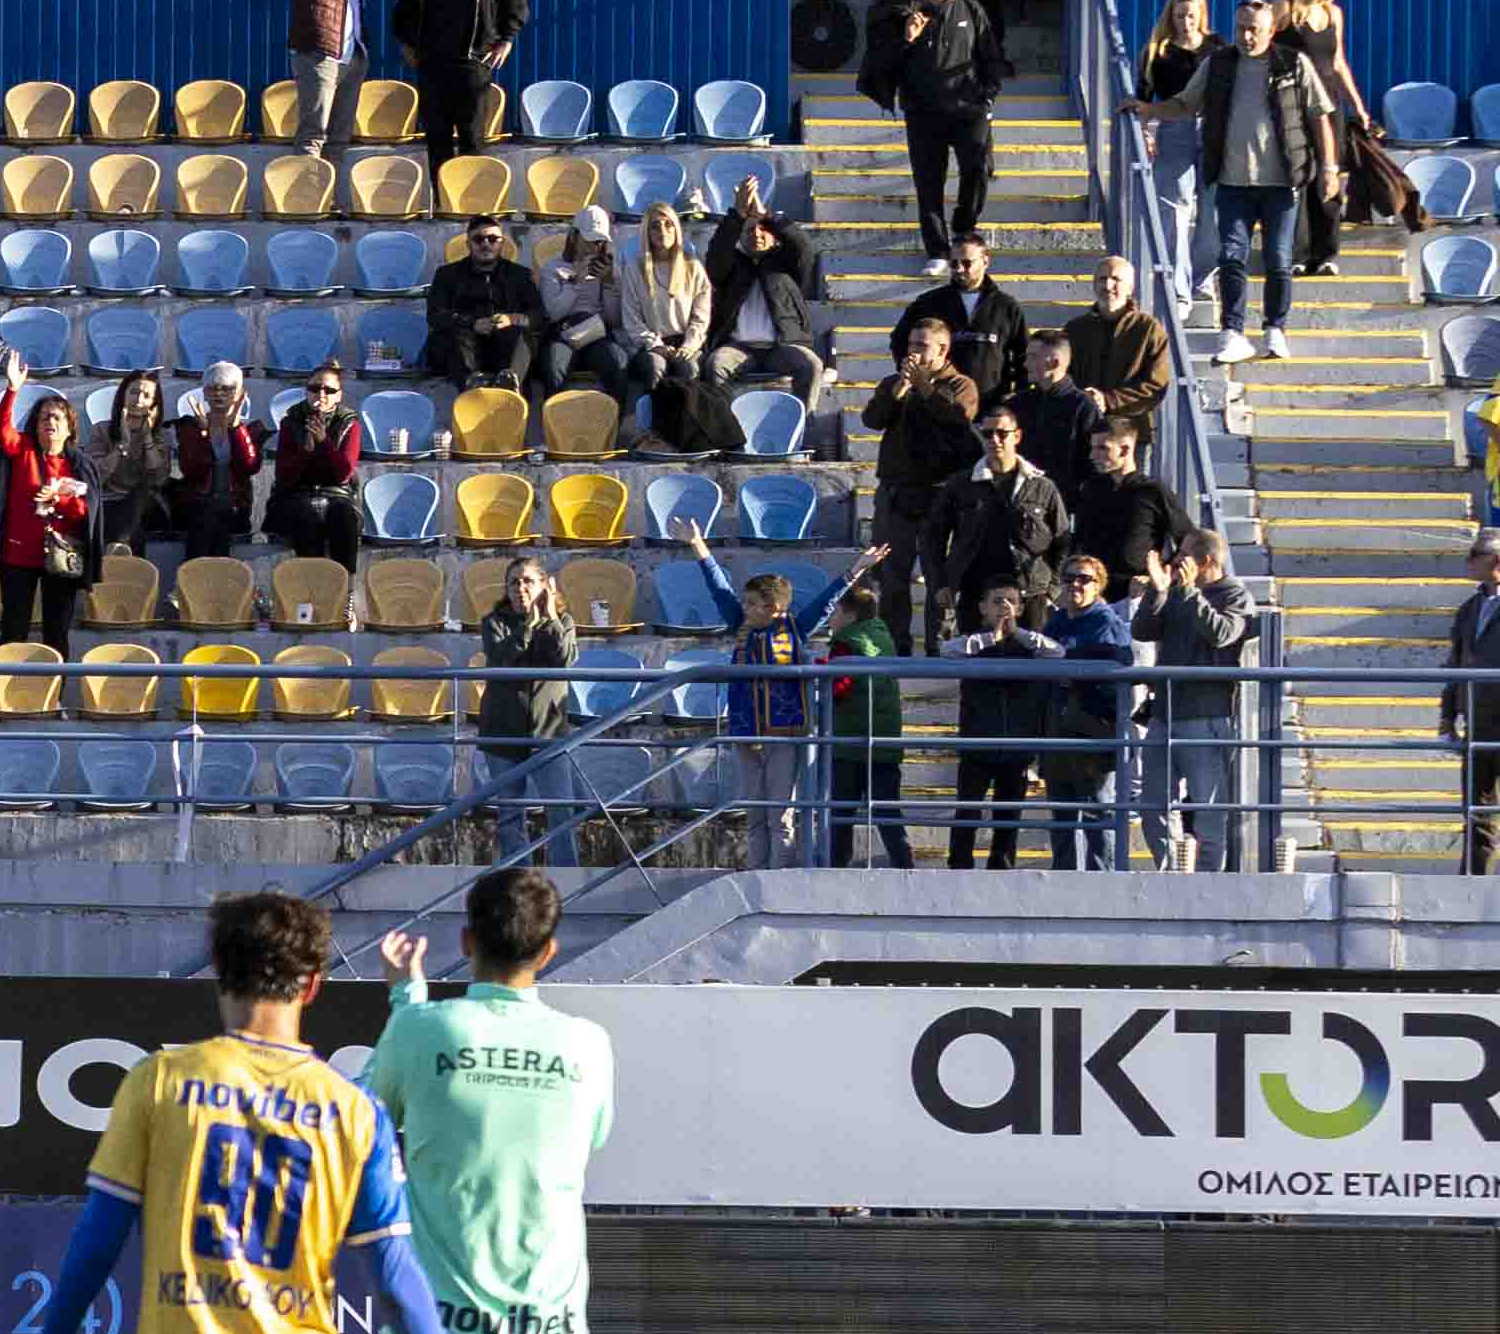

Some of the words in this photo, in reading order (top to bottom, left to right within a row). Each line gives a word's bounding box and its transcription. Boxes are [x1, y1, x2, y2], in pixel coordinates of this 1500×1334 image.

[435, 1047, 582, 1083] ASTERAS
[180, 1078, 341, 1128] novibet
[1198, 1170, 1333, 1197] ΟΜΙΛΟΣ
